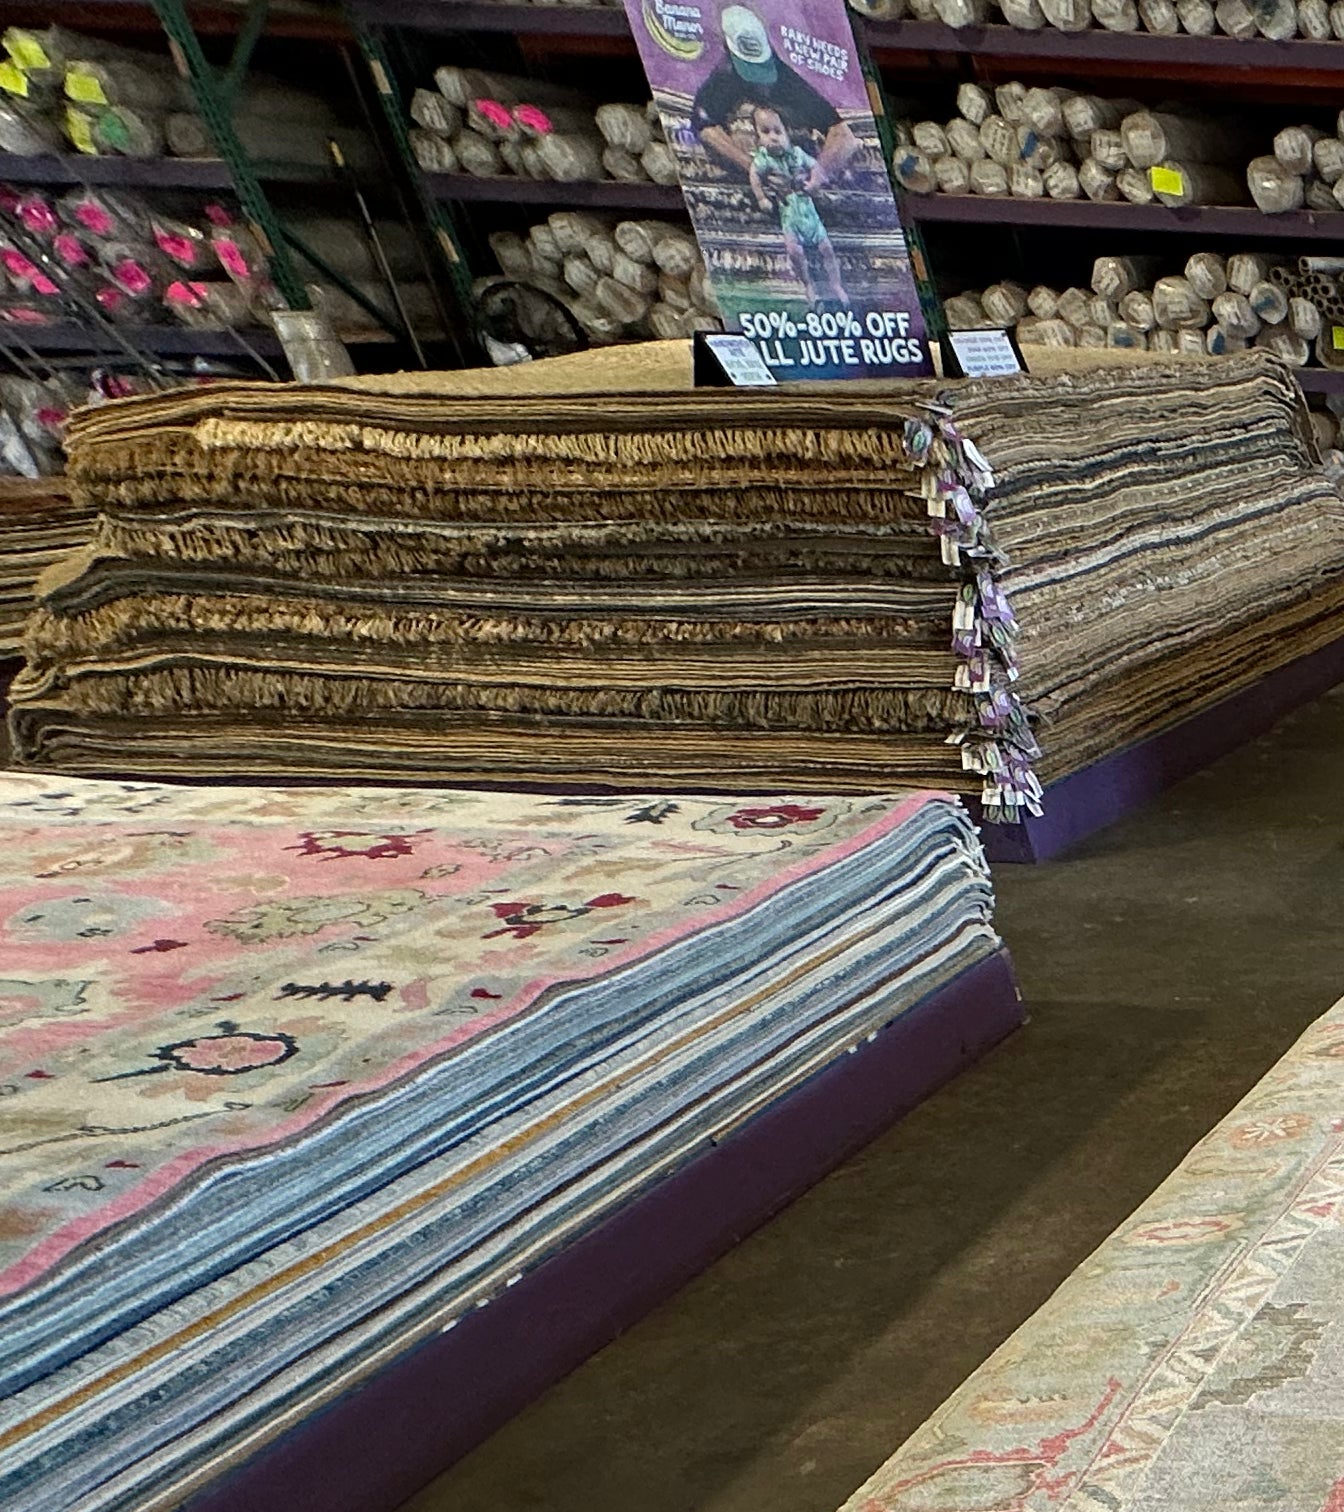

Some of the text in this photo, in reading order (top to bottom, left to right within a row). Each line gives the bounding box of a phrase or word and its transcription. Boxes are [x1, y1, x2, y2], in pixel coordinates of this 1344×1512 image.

[780, 24, 848, 60] BABY NEEDS
[783, 38, 849, 73] A NEW PAIR
[790, 52, 844, 81] OF SHOES
[738, 311, 911, 339] 50%-80% OFF
[756, 337, 924, 366] LL JUTE RUGS
